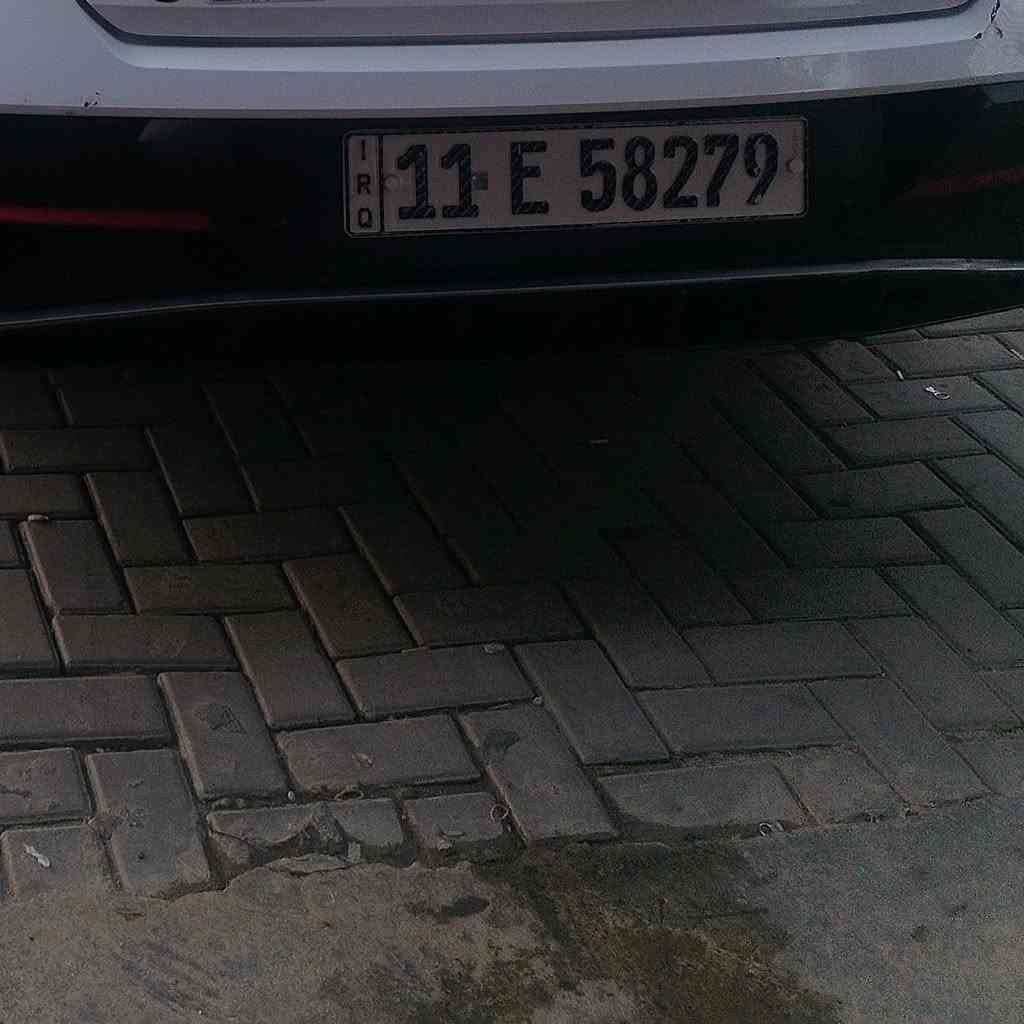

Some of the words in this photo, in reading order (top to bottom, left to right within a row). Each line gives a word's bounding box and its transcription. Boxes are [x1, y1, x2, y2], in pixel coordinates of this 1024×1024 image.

[355, 138, 374, 229] IRQ
[396, 143, 480, 220] 11
[509, 139, 550, 216] E
[579, 131, 779, 213] 58279
